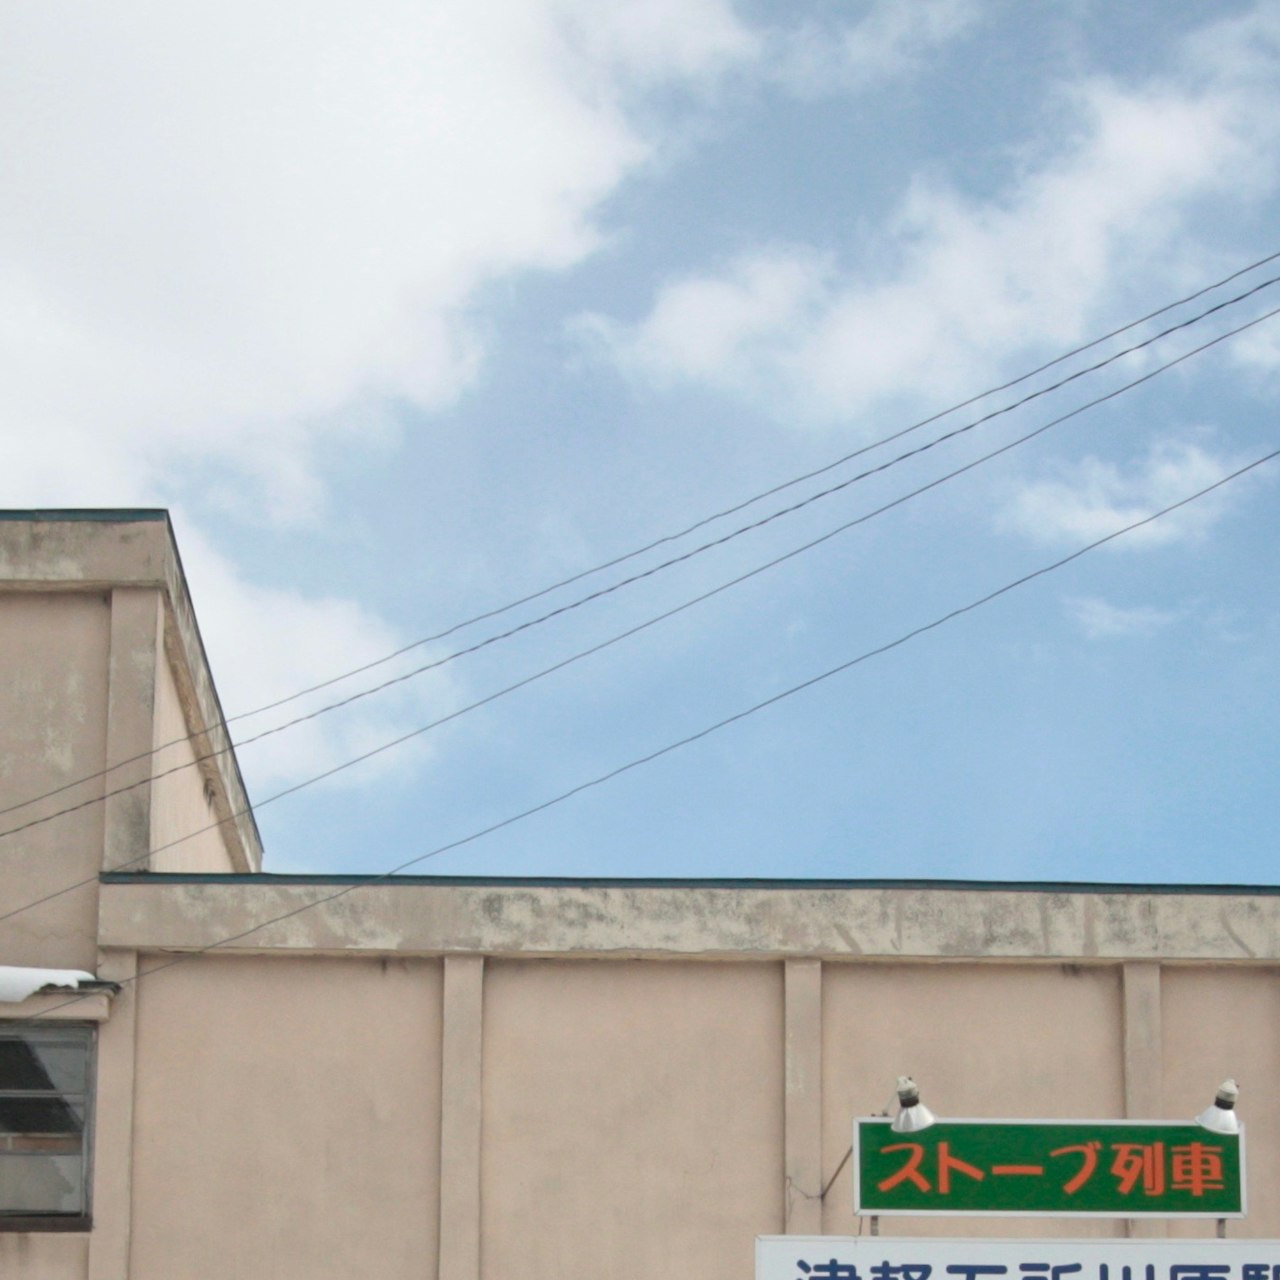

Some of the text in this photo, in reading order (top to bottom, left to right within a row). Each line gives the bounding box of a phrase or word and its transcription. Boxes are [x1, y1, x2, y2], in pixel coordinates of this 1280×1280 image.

[876, 1141, 1226, 1198] ストーブ列車
